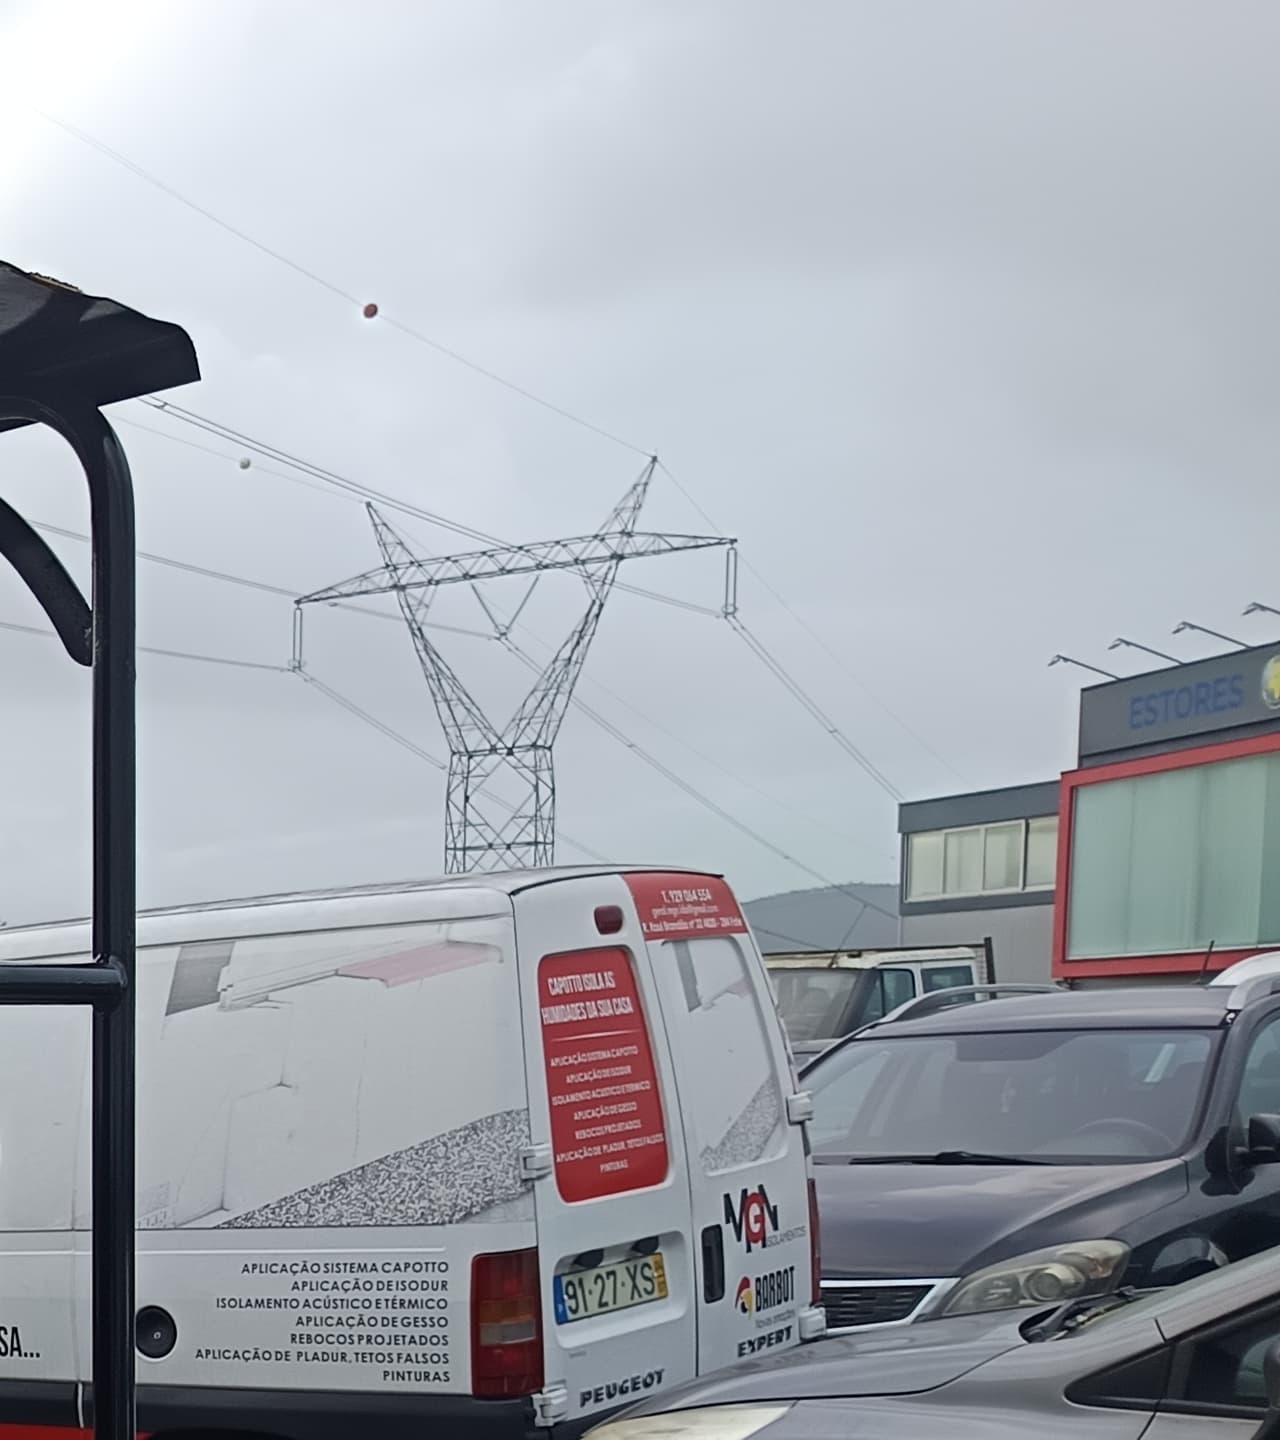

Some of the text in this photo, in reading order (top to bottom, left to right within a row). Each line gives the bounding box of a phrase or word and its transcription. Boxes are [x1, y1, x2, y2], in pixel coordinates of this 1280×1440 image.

[1130, 672, 1246, 730] ESTORES
[547, 971, 616, 996] CAPOTTO ISOLA AS
[541, 996, 634, 1025] HUMIDADES DA SUA CASA
[600, 1159, 628, 1173] PINTURAS
[723, 1184, 779, 1253] MGN
[241, 1260, 449, 1276] APLICAÇÃO SISTEMA CAPOTTO
[291, 1278, 449, 1294] APLICAÇÃO DE ISODUR
[755, 1265, 795, 1312] BARBOT
[216, 1295, 448, 1309] ISOLAMENTO ACÚSTICO E TÉRMICO
[296, 1314, 448, 1329] APLICAÇÃO DE GESSO
[290, 1333, 449, 1346] REBOCOS PROJETADOS
[738, 1325, 792, 1358] EXPERT
[195, 1347, 272, 1363] APLICAÇÃO
[275, 1350, 291, 1361] DE
[354, 1352, 394, 1363] TETOS
[397, 1353, 450, 1364] FALSOS
[383, 1370, 450, 1382] PINTURAS
[580, 1368, 665, 1408] PEUGEOT
